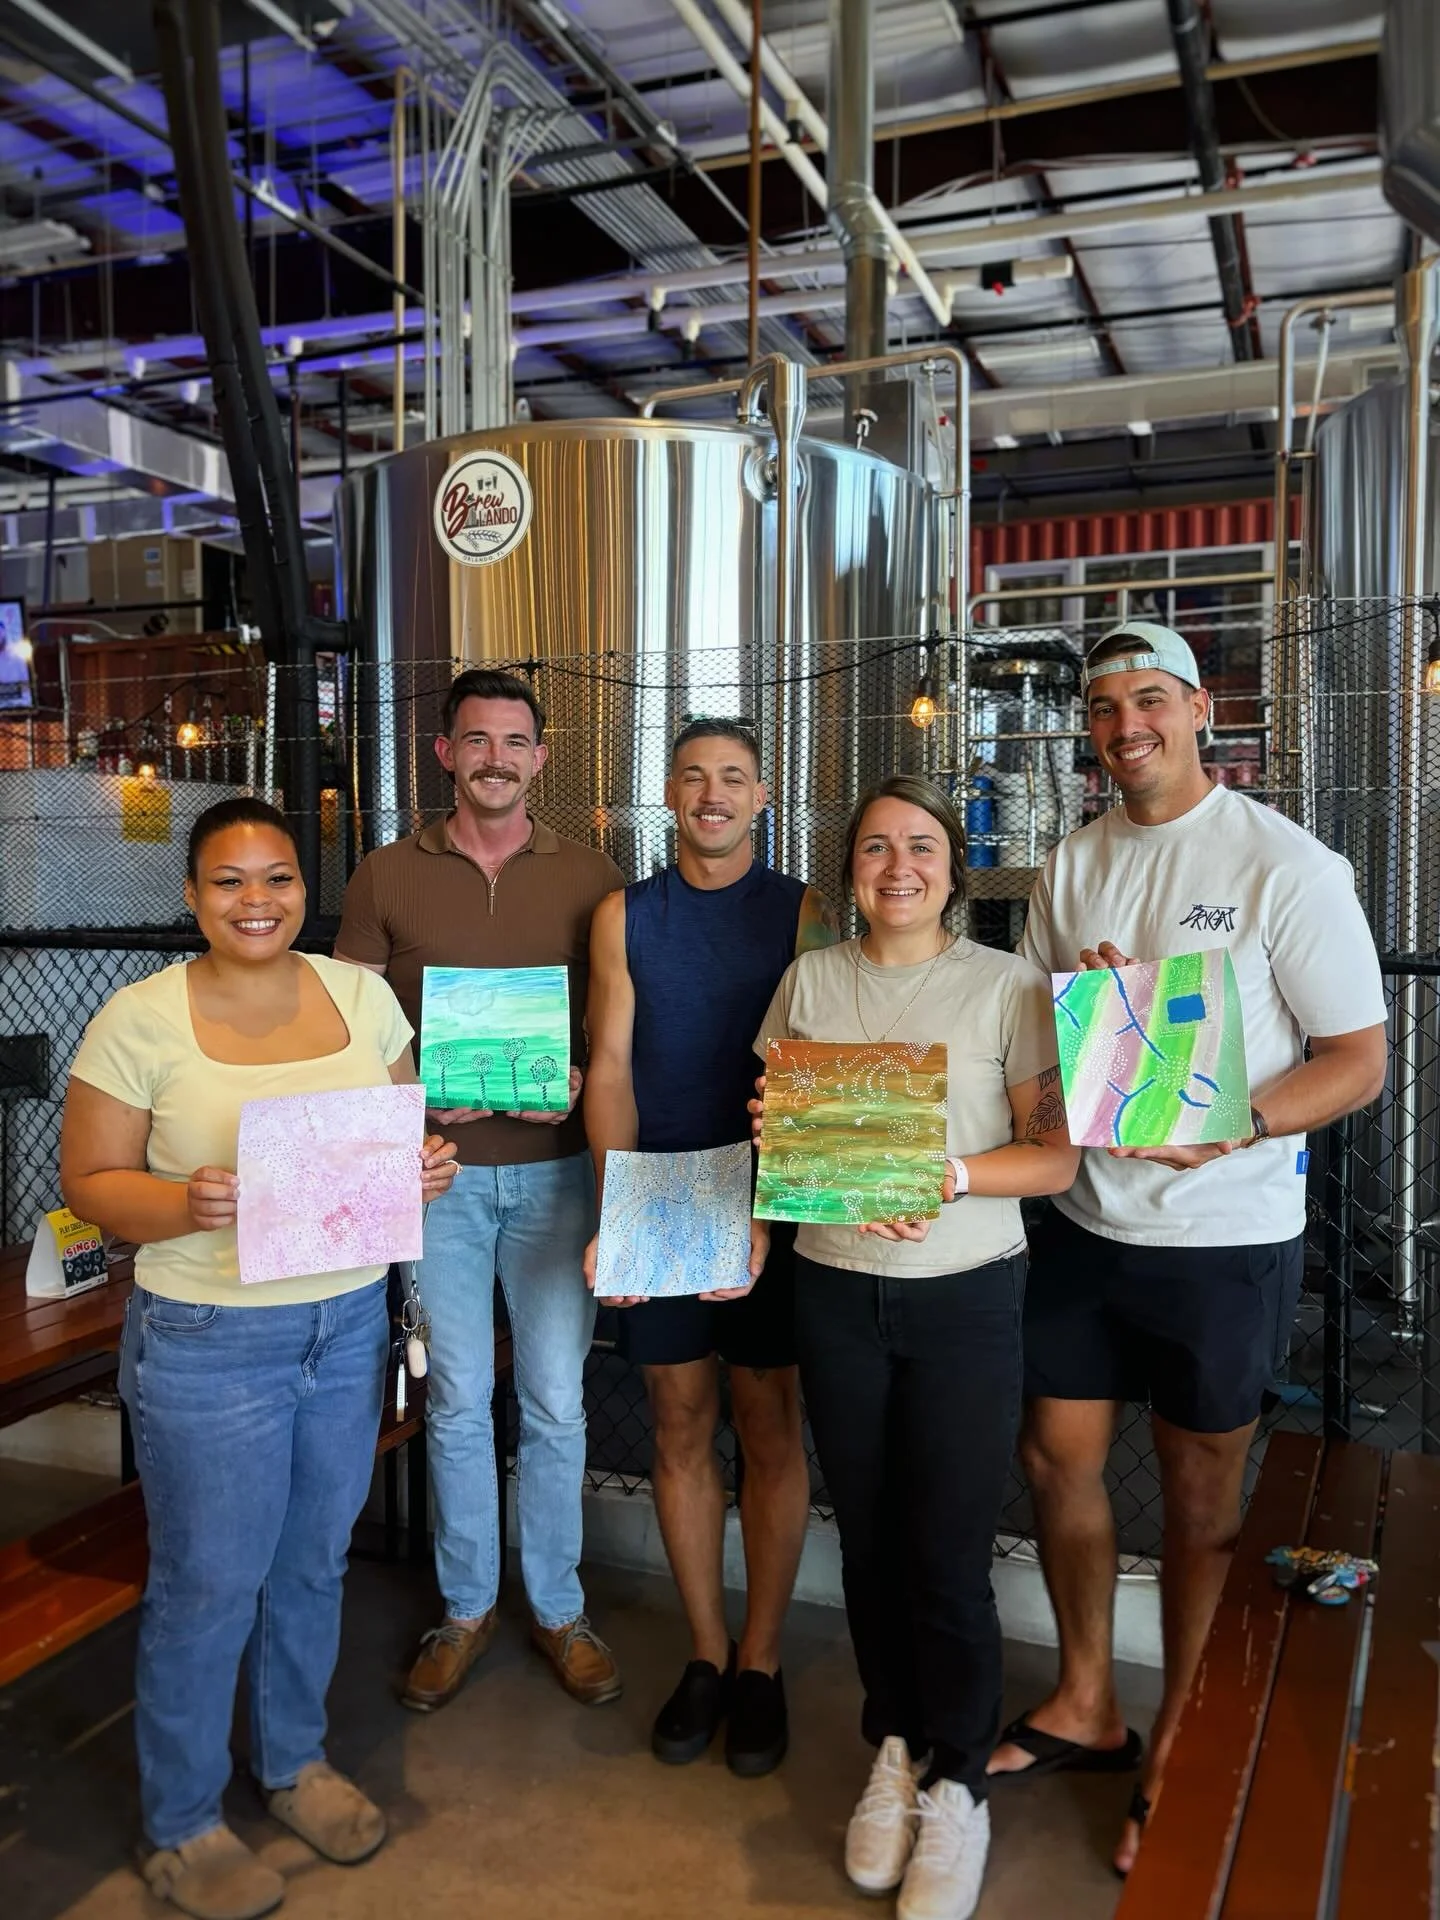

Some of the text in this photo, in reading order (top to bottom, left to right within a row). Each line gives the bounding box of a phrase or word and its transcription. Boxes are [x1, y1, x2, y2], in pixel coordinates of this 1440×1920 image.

[442, 482, 504, 539] Brew
[479, 506, 518, 526] LANDO
[66, 1240, 97, 1257] SINGO
